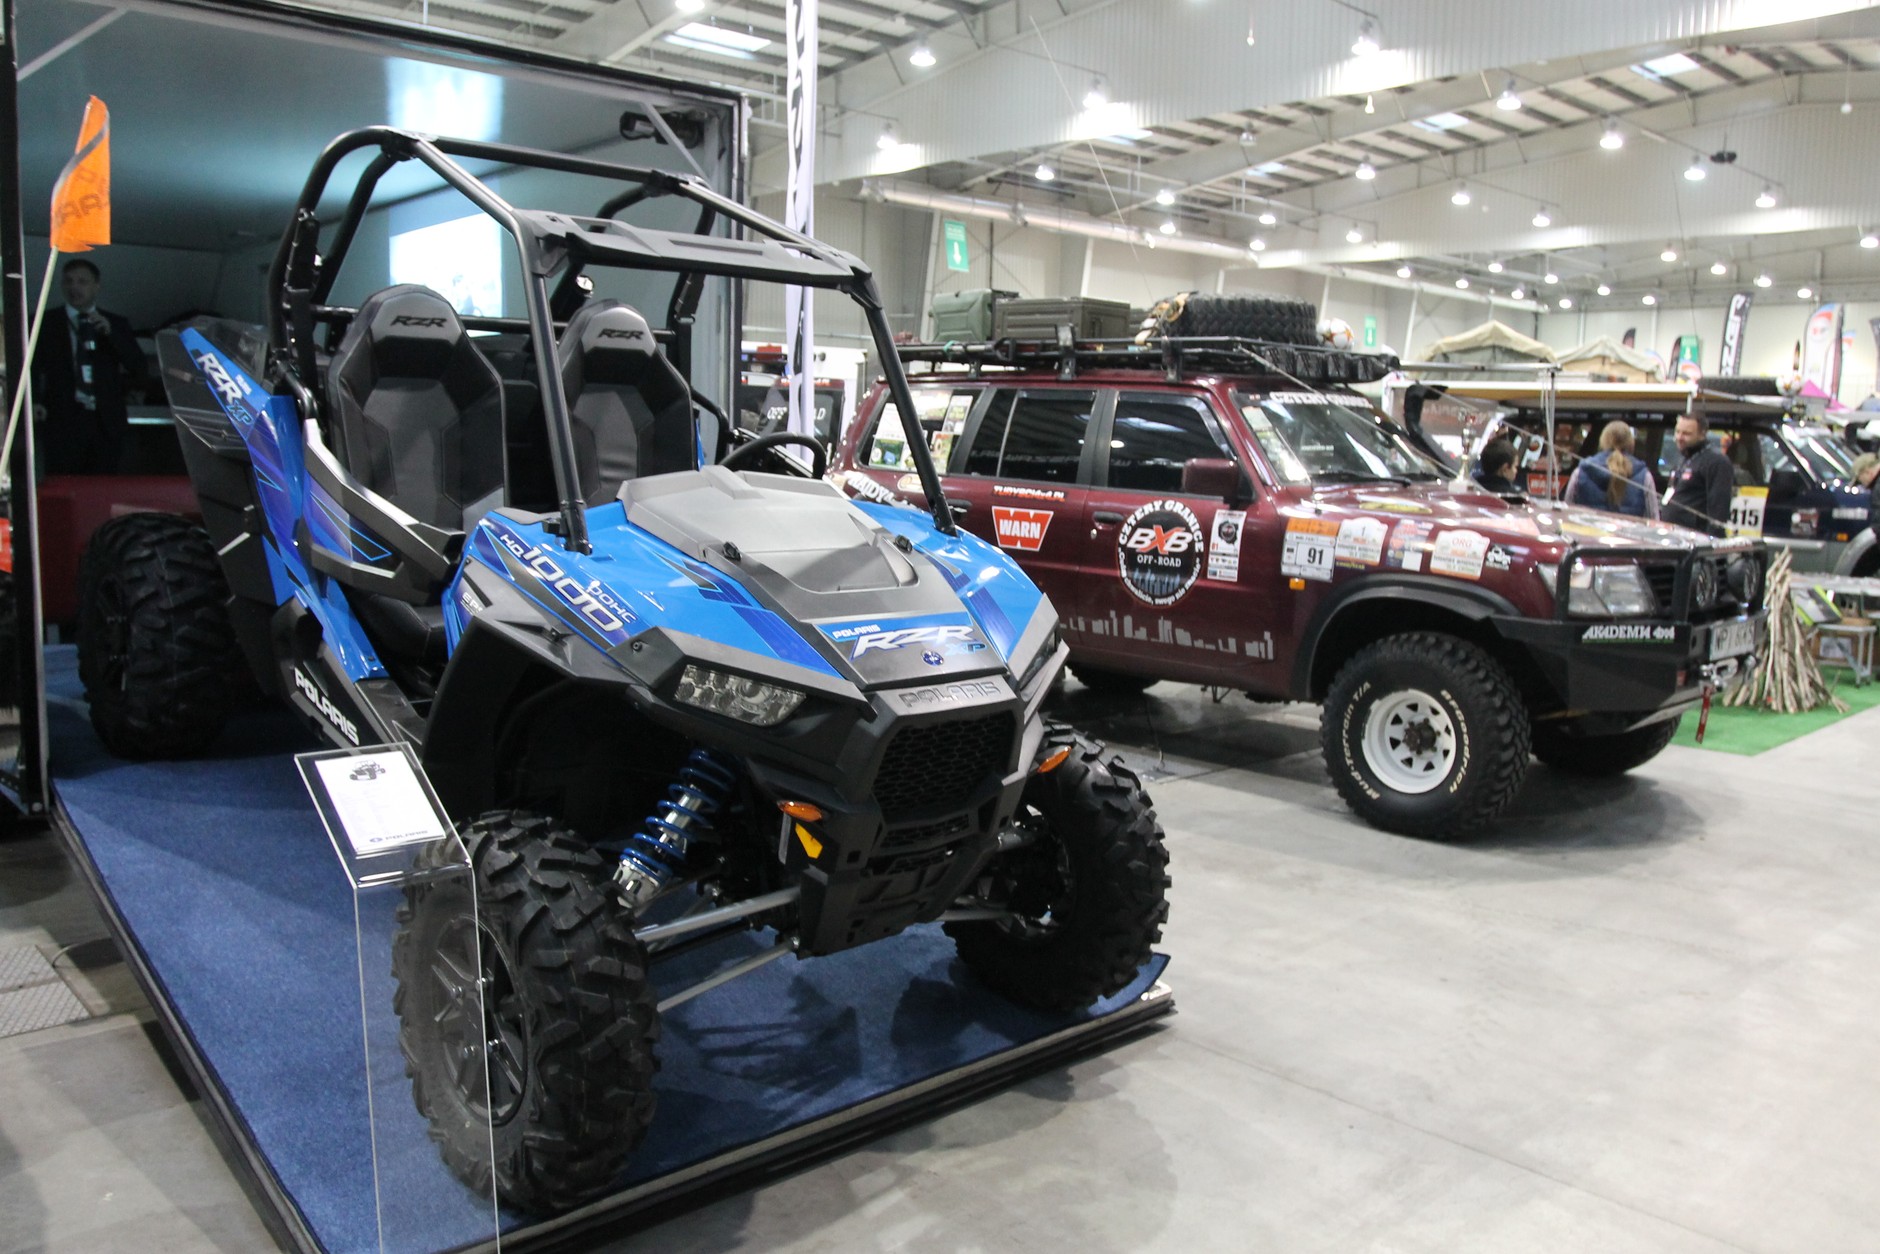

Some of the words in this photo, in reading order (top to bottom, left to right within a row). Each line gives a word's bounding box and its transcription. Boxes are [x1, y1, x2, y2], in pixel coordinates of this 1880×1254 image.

[391, 315, 447, 328] RZR
[598, 328, 644, 341] RZR
[196, 352, 243, 405] RZR
[226, 399, 255, 425] XP
[999, 518, 1041, 539] WARN
[1119, 500, 1162, 545] CZTERY
[1164, 500, 1204, 552] GRANICE
[1127, 524, 1193, 555] BXB
[1307, 547, 1324, 566] 91
[1452, 538, 1473, 548] ORG
[523, 546, 624, 632] 1000
[586, 583, 638, 624] DOHC
[832, 624, 881, 639] POLARIS
[850, 625, 978, 662] RZR
[943, 642, 988, 657] XP
[294, 667, 360, 746] POLARIS
[898, 681, 1001, 708] POLARIS
